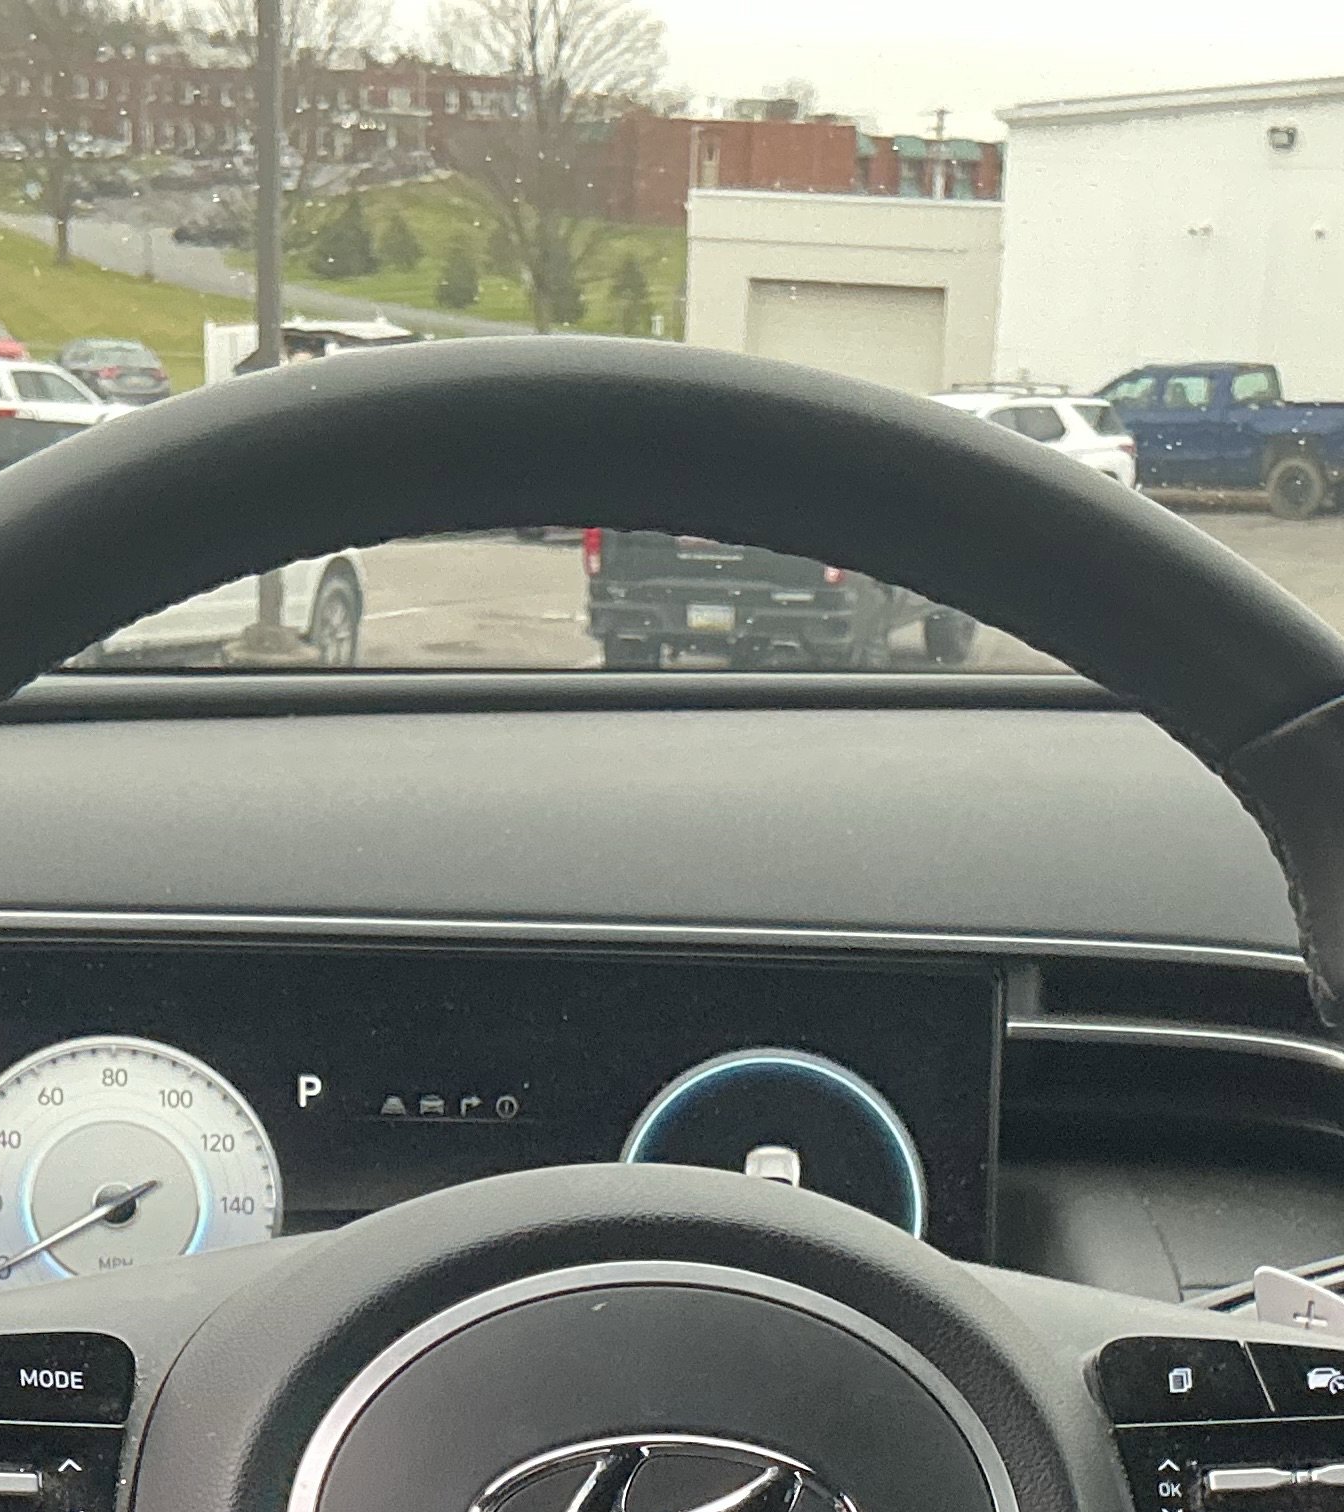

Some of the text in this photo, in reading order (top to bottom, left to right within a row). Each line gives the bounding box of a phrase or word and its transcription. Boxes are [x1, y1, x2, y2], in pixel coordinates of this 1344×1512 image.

[101, 1068, 128, 1087] 80
[37, 1087, 64, 1106] 60
[159, 1089, 193, 1109] 100
[299, 1075, 322, 1108] P
[201, 1133, 235, 1153] 120
[221, 1196, 255, 1216] 140
[19, 1368, 84, 1390] MODE
[1158, 1481, 1182, 1498] OK
